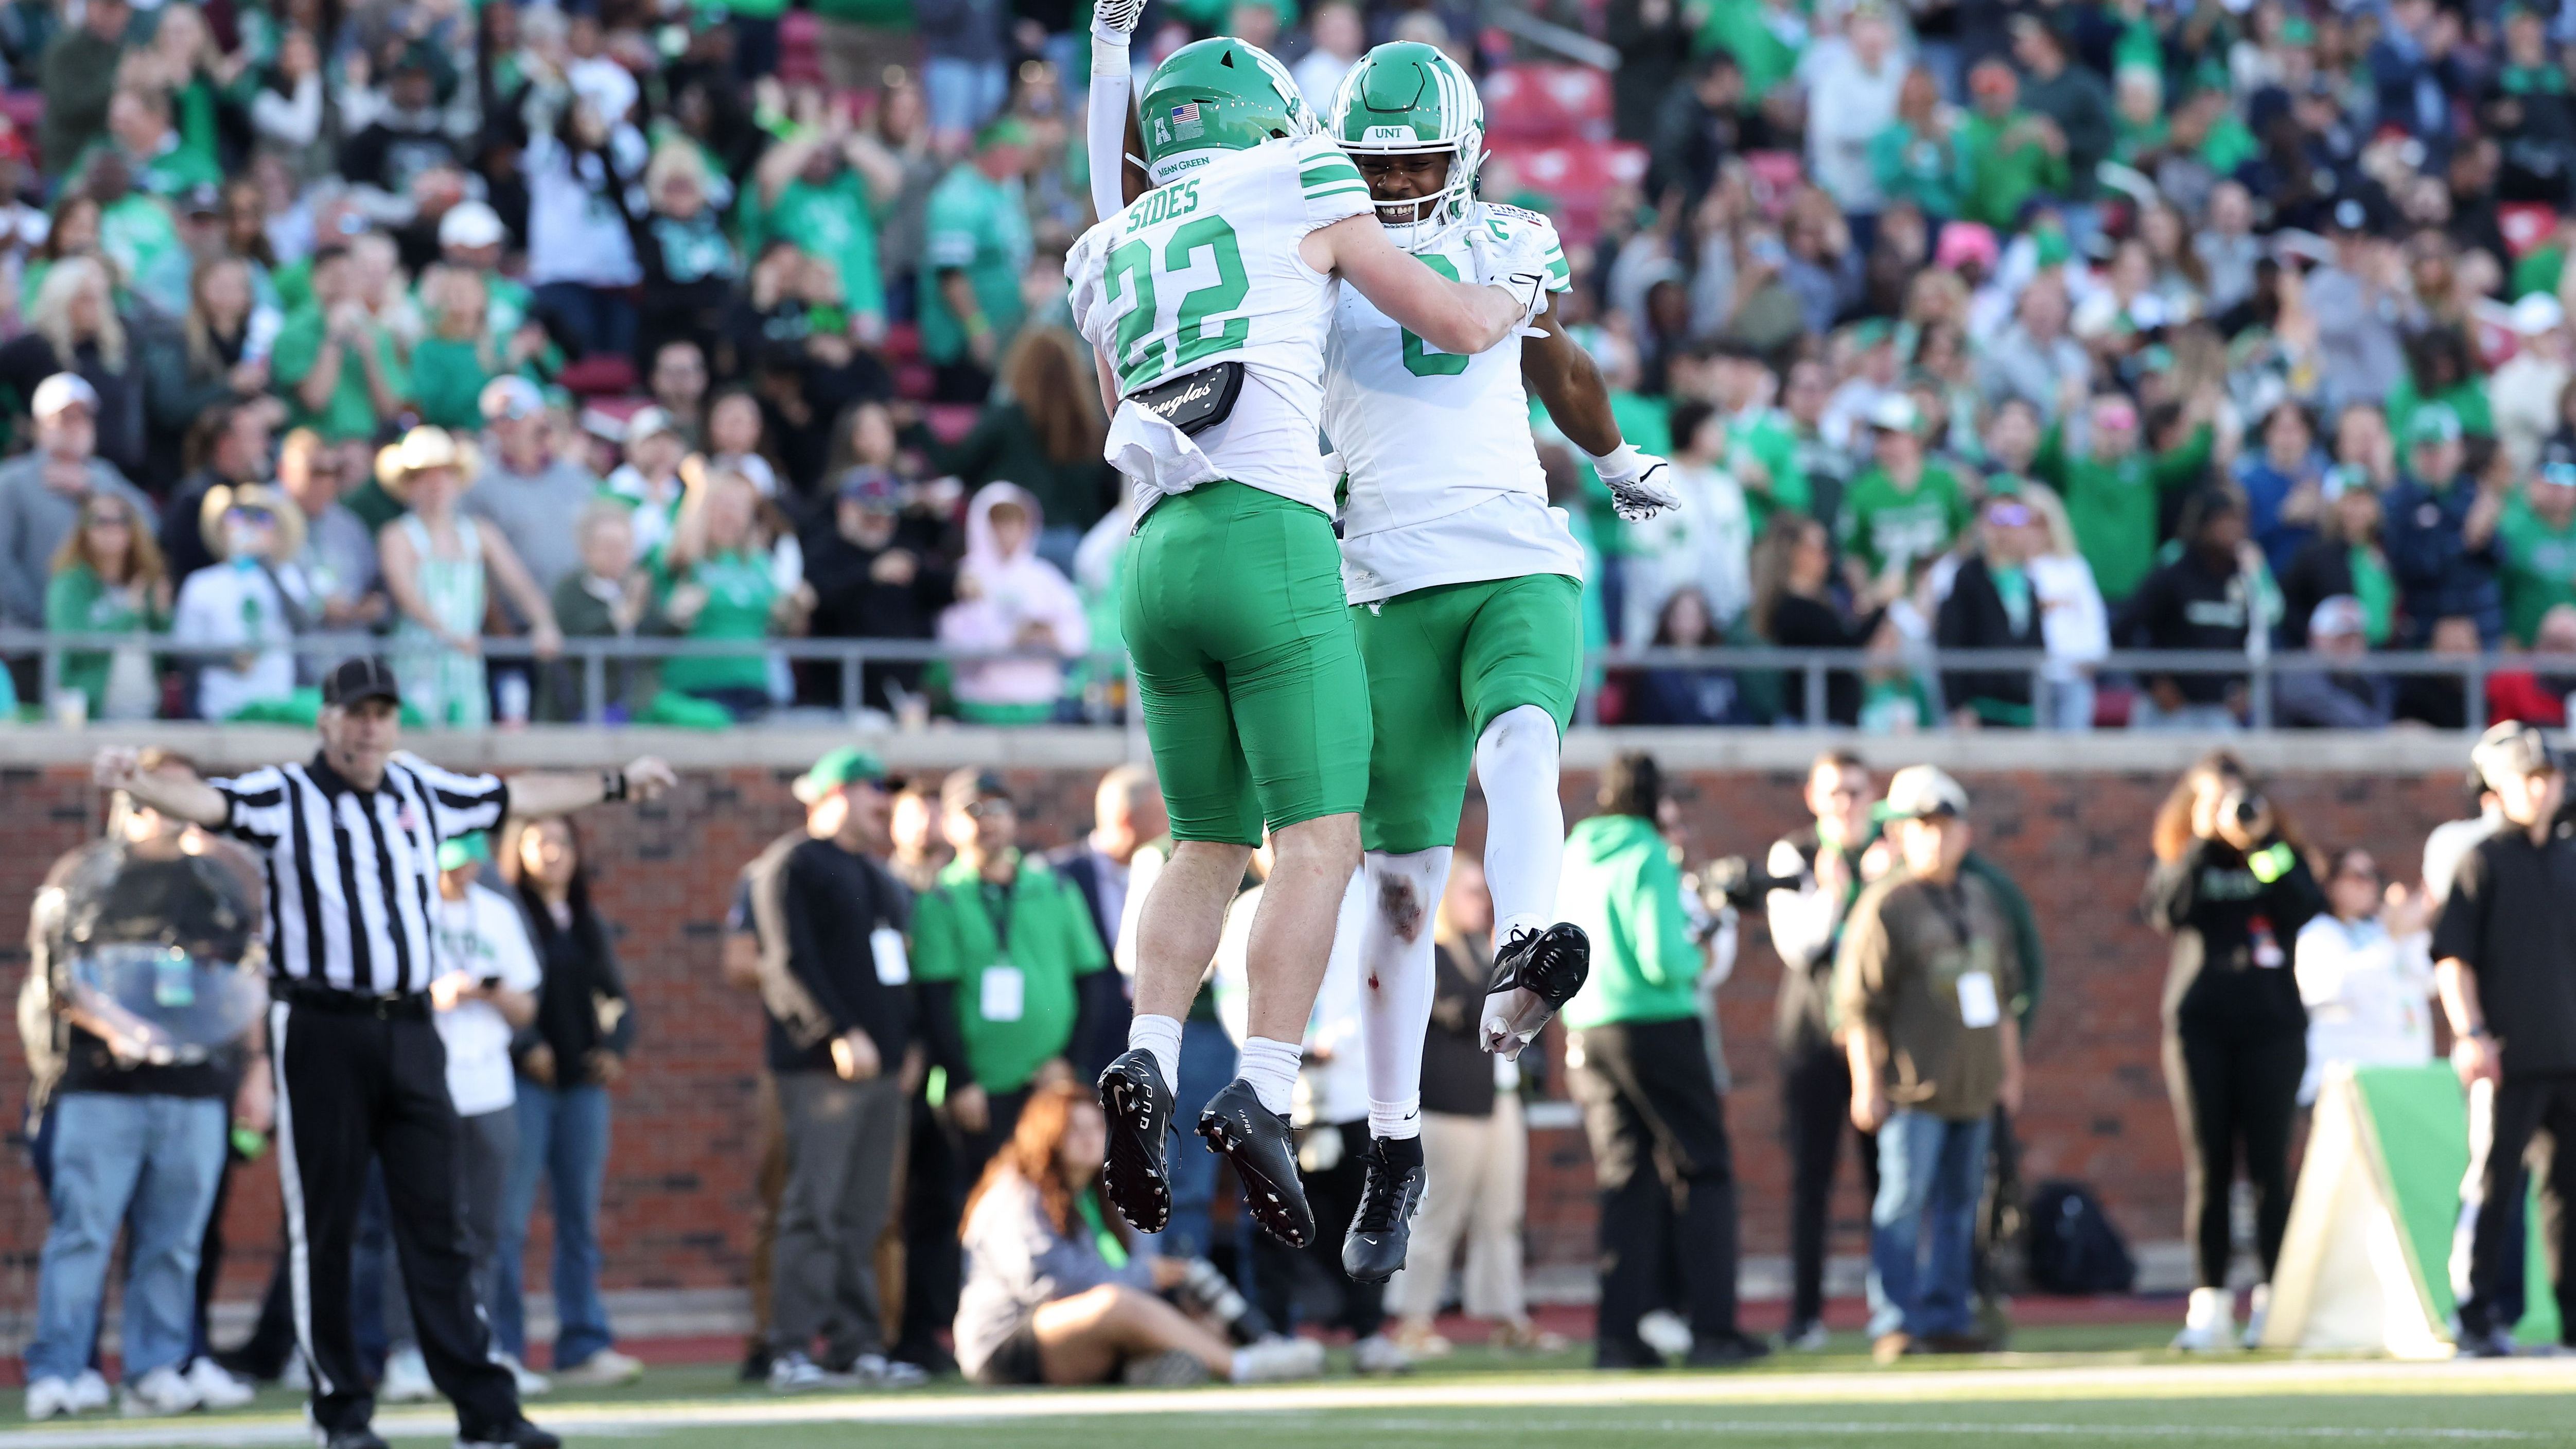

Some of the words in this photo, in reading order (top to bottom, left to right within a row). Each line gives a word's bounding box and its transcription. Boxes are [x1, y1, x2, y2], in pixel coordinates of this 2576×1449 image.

[1375, 128, 1402, 138] UNT
[1158, 164, 1178, 178] MEAN
[1179, 156, 1210, 170] GREEN
[1126, 178, 1200, 235] SIDES
[1103, 214, 1250, 397] 22
[1238, 1109, 1252, 1134] VAPOR
